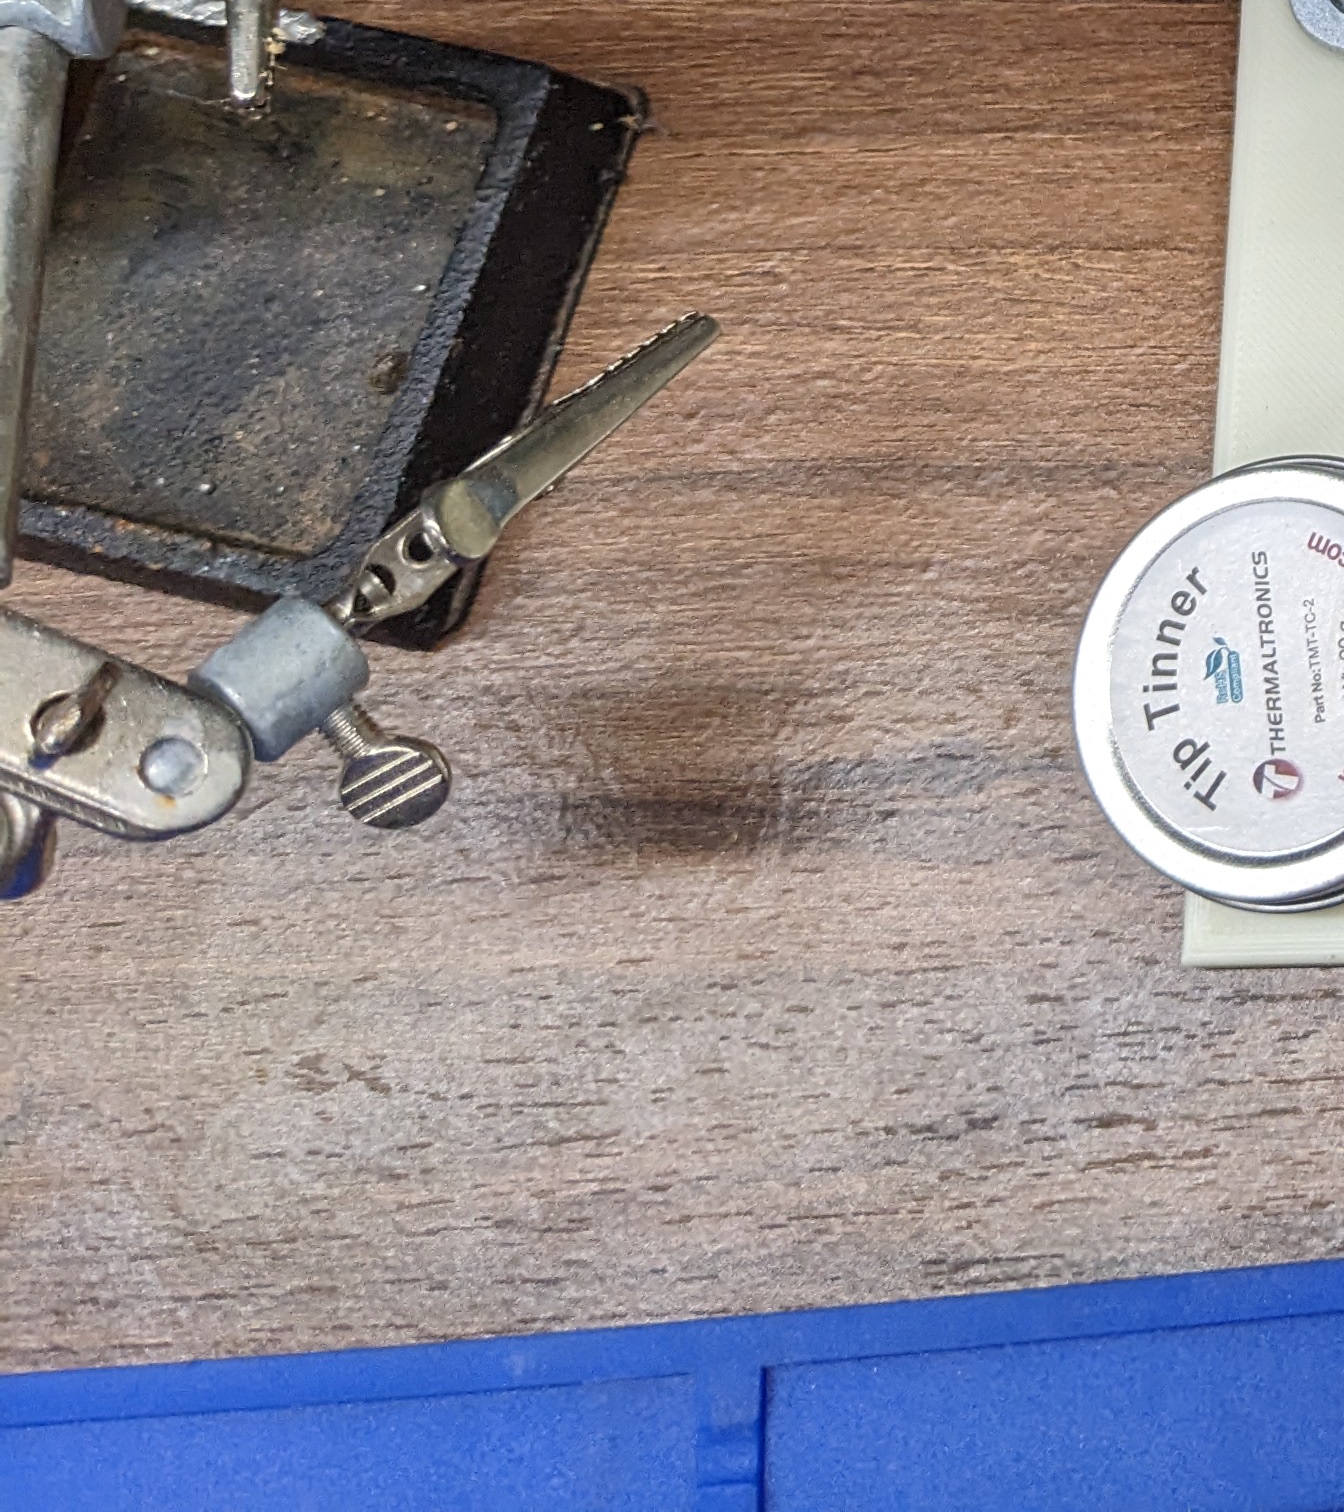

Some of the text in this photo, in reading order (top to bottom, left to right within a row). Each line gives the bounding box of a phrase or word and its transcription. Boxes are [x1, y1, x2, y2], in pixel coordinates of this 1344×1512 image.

[1142, 565, 1228, 812] Tip Tinner
[1251, 550, 1287, 756] THERMALTRONICS
[1311, 693, 1328, 724] Part
